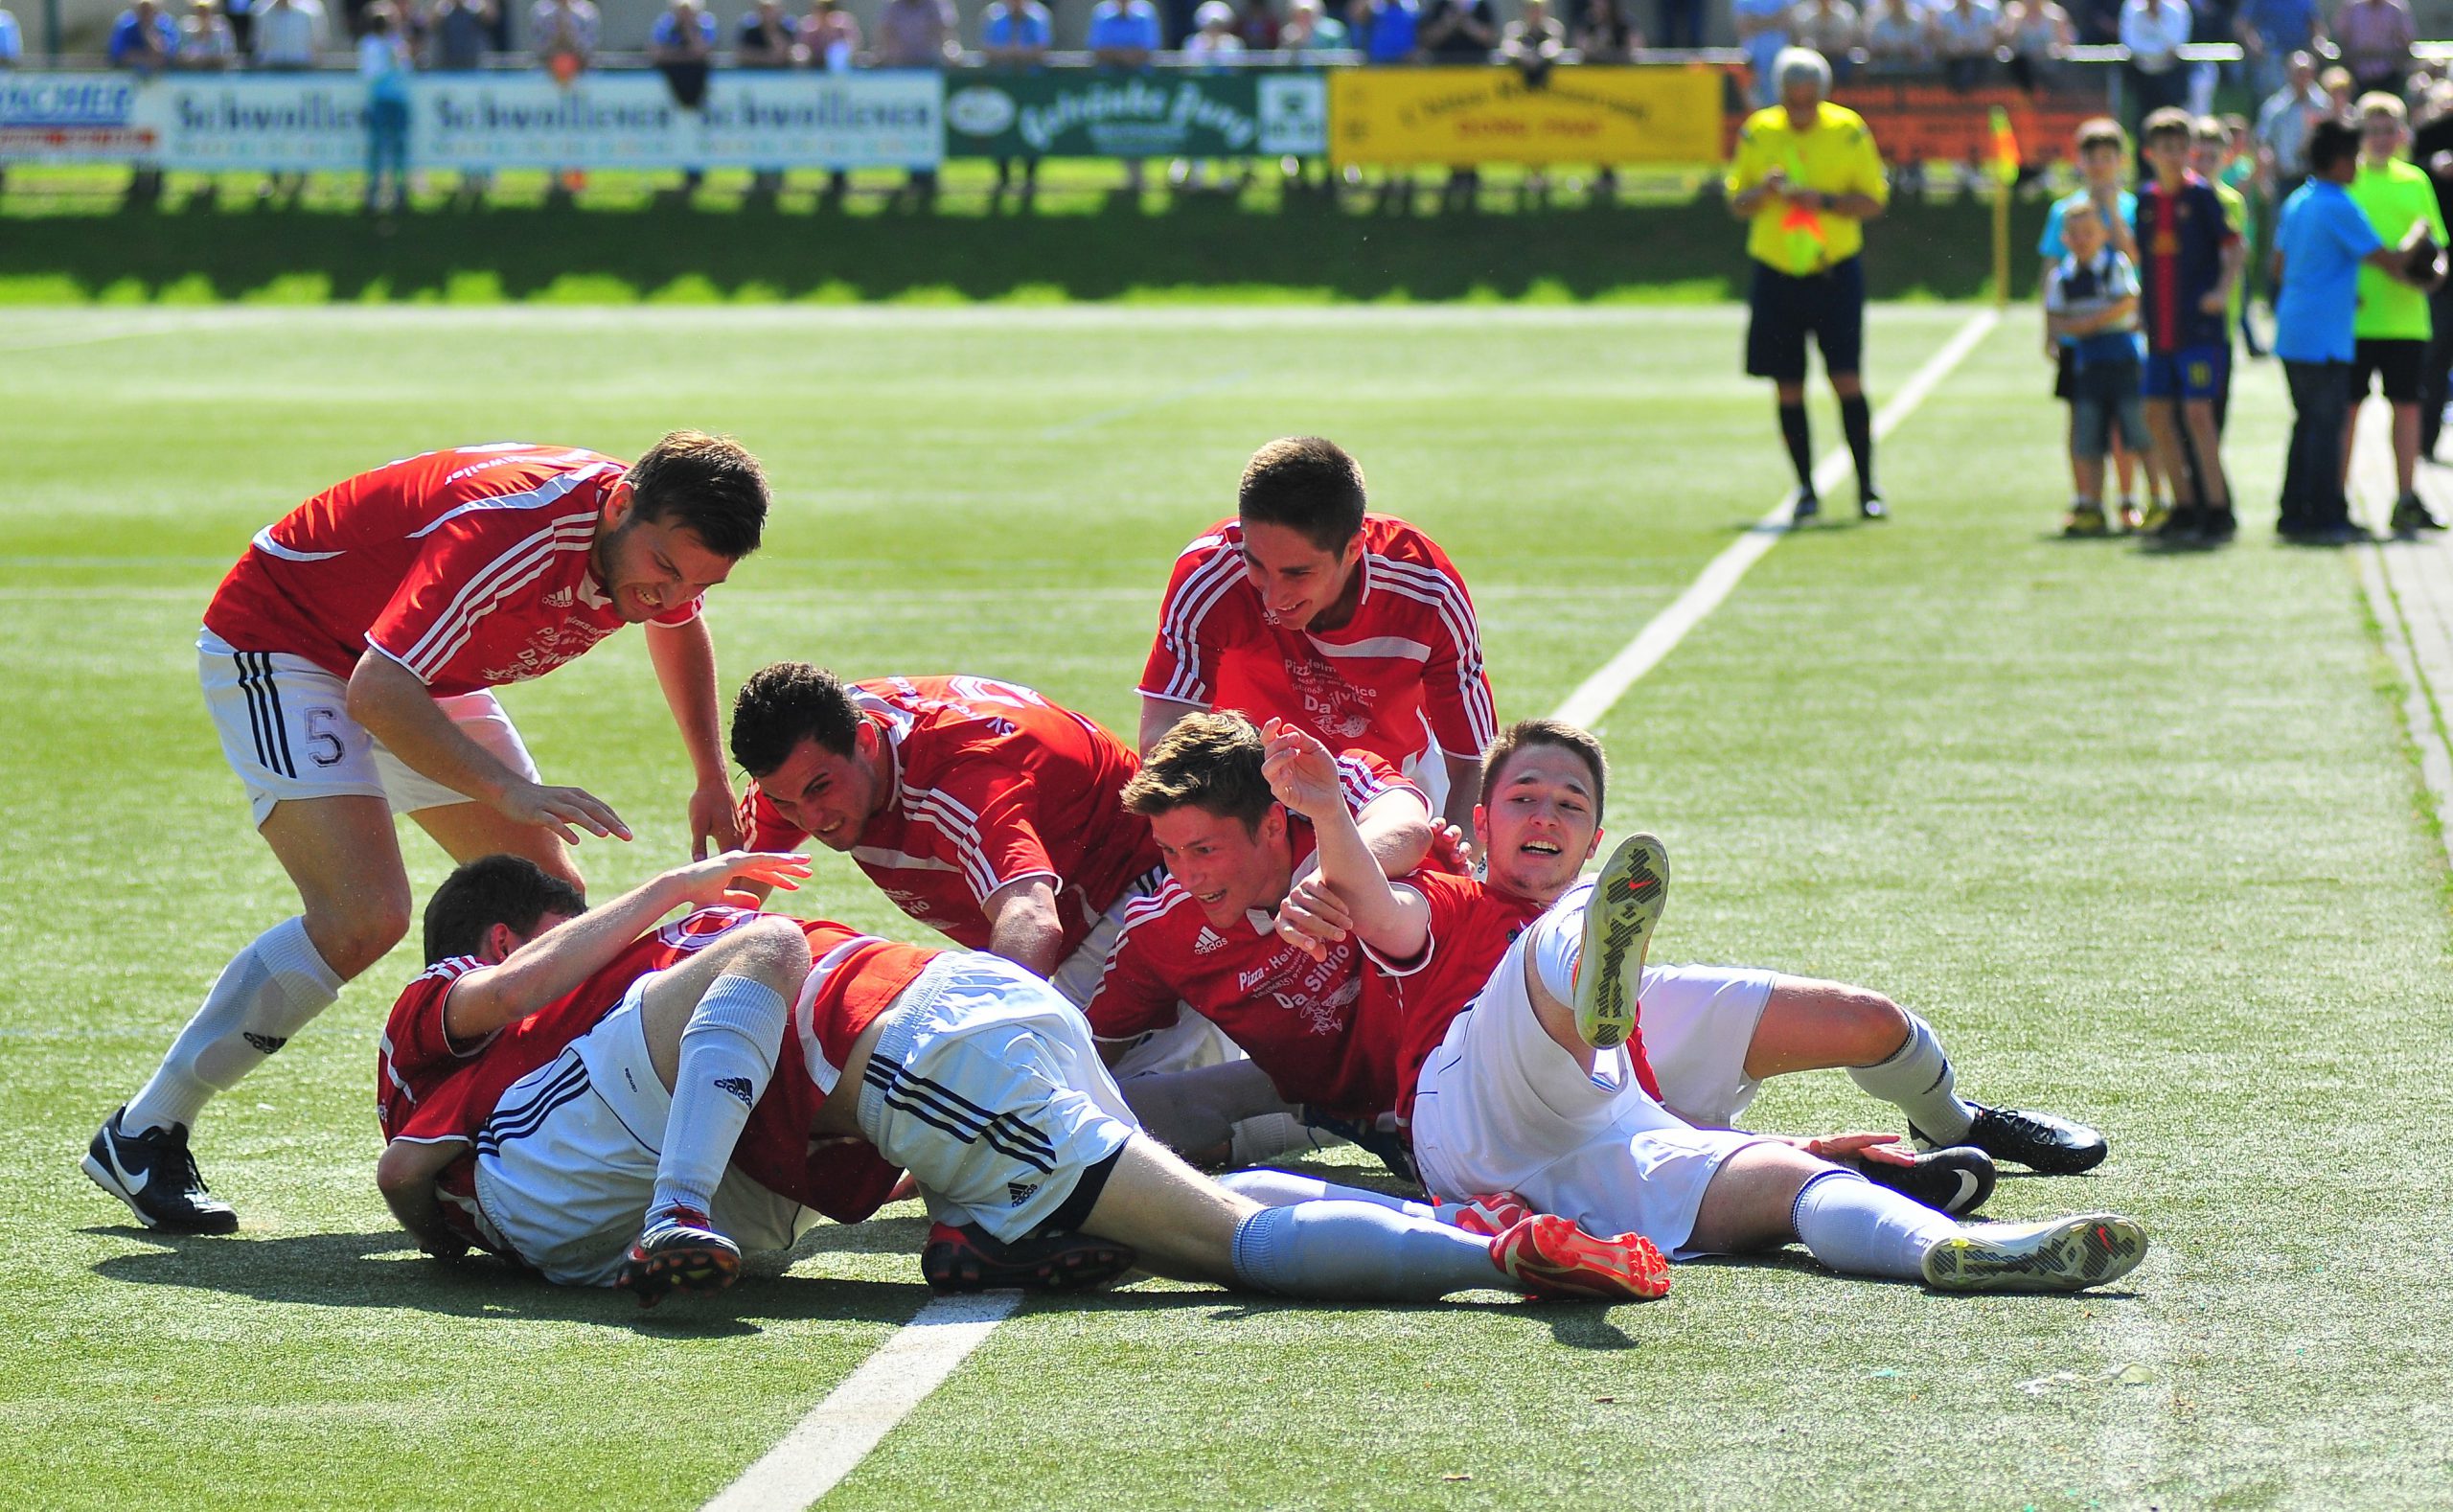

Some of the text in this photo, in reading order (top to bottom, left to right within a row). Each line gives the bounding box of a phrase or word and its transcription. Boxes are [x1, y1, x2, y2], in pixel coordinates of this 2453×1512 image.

[541, 596, 574, 607] adidas
[1305, 694, 1331, 714] Da
[304, 707, 346, 767] 5
[1194, 937, 1228, 955] adidas
[1239, 967, 1265, 992] Pizza
[1272, 944, 1350, 1010] Da Silvio
[1011, 1183, 1038, 1207] adidas
